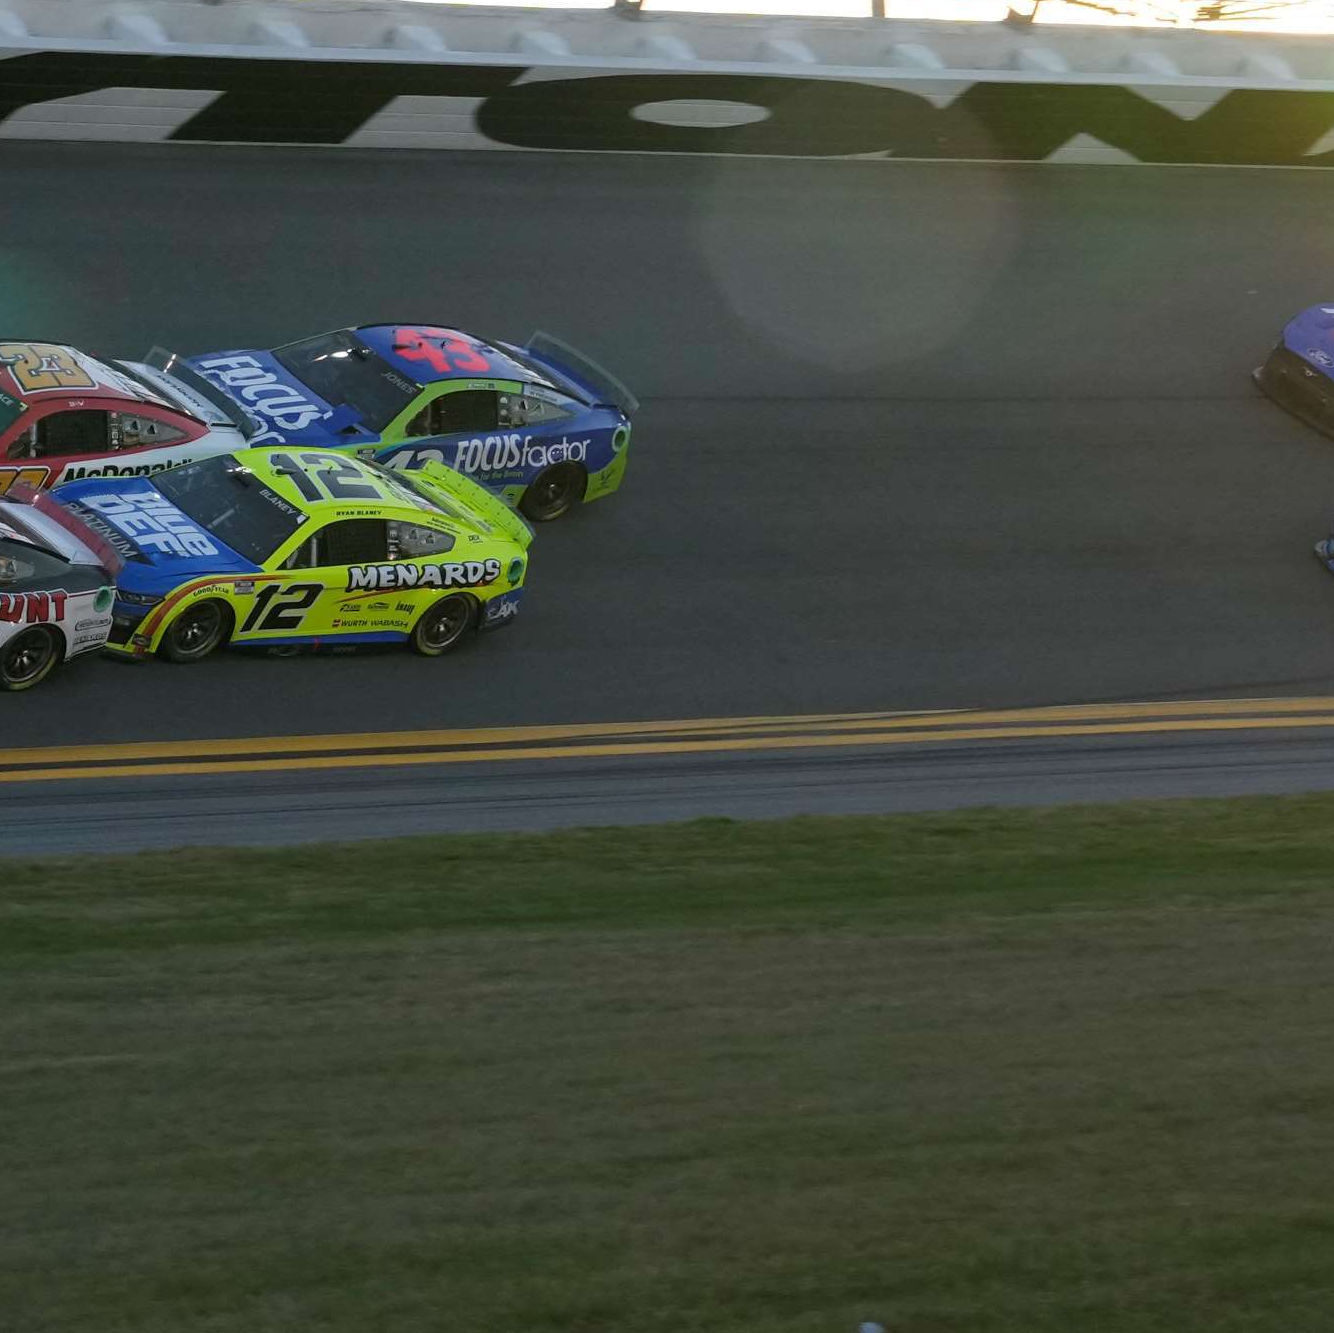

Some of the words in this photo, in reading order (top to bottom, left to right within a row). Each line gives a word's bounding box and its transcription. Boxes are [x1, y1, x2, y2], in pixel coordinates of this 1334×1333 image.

[394, 329, 491, 373] 43
[199, 355, 319, 430] FOCUS
[382, 371, 417, 395] JONES
[259, 489, 297, 516] BLANEY
[269, 453, 384, 503] 12
[67, 502, 139, 559] PLATINUM
[80, 494, 190, 558] DEF
[346, 559, 501, 592] MENARDS
[239, 582, 324, 633] 12
